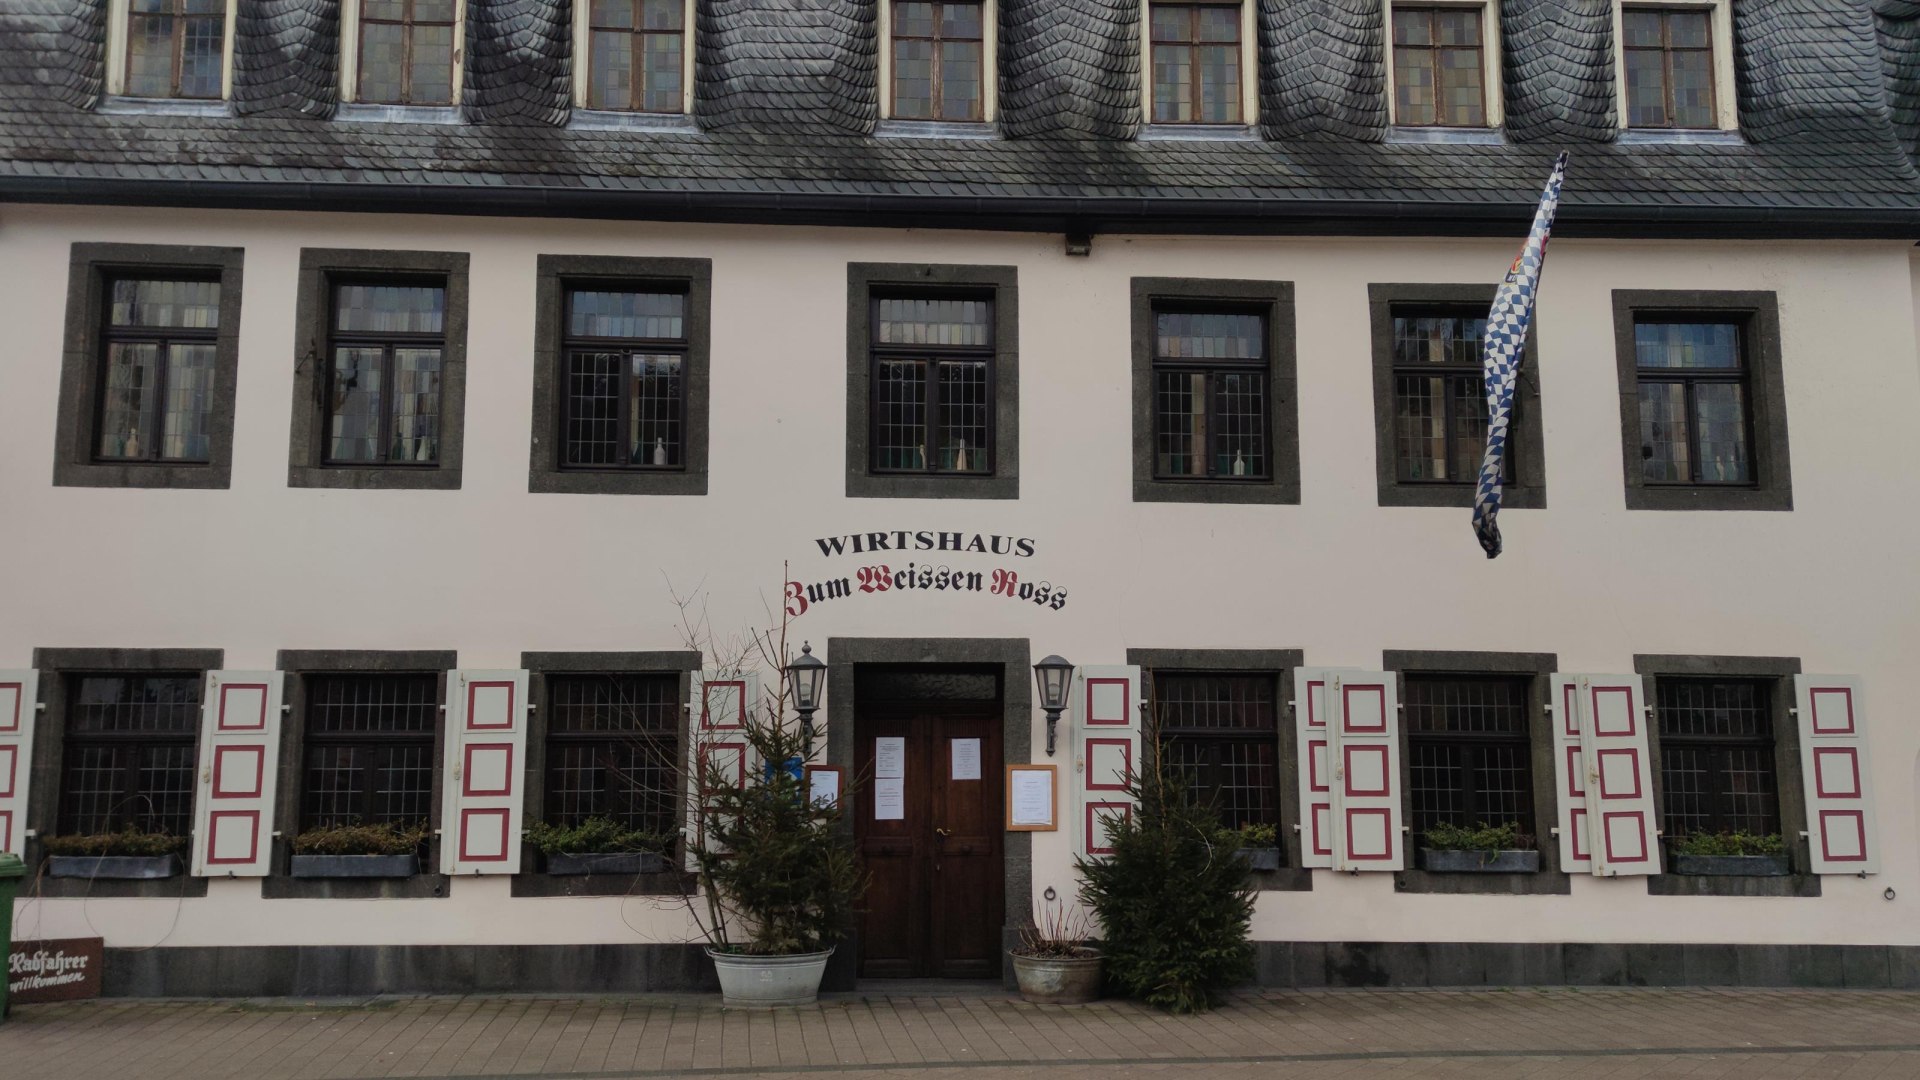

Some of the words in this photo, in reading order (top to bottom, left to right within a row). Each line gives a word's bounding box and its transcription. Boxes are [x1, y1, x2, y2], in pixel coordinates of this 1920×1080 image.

[815, 531, 1035, 557] WIRTSHAUS
[785, 577, 852, 616] Zum
[857, 562, 983, 593] Weissen
[990, 569, 1067, 611] Ross
[8, 950, 88, 975] Radfahrer
[9, 972, 85, 993] willkommen
